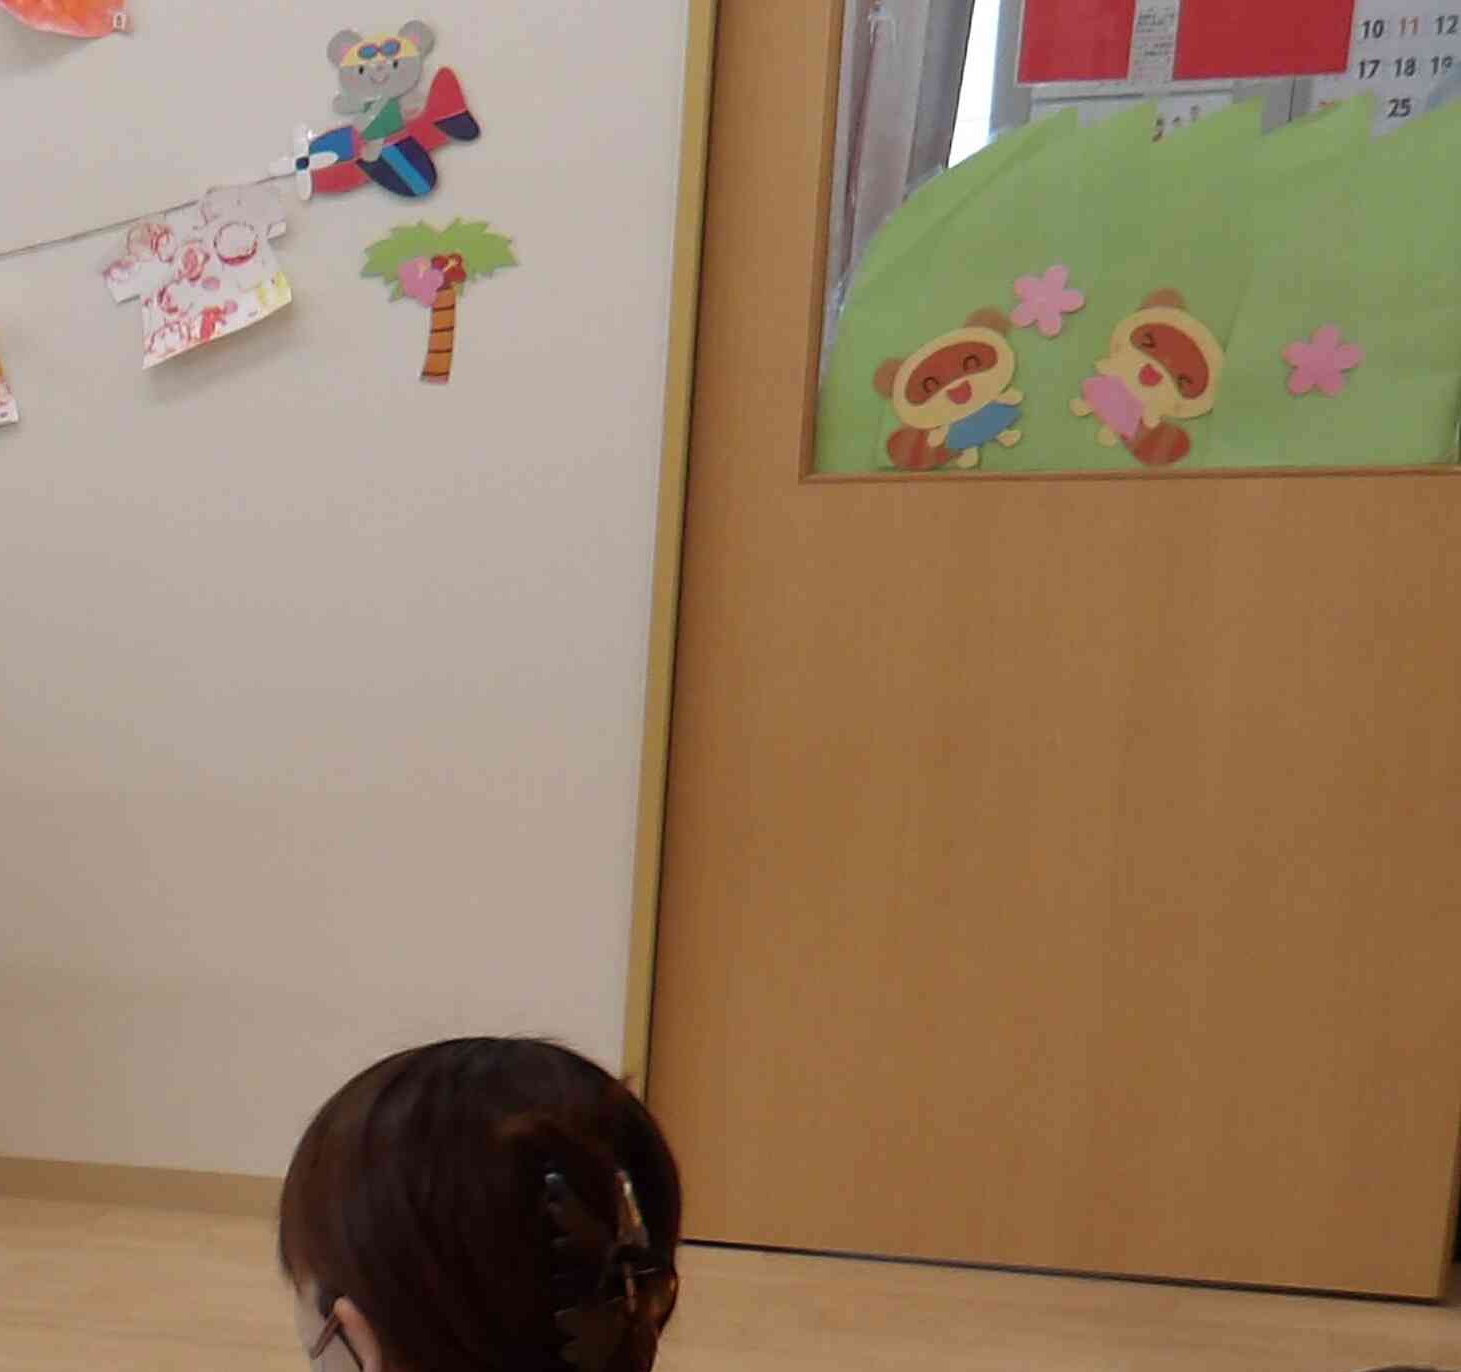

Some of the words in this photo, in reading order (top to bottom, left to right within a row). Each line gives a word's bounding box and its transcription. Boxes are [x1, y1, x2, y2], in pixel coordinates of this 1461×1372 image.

[1361, 19, 1384, 39] 10
[1399, 16, 1419, 36] 11
[1435, 14, 1459, 36] 12
[1359, 58, 1381, 79] 17
[1394, 56, 1417, 78] 18
[1387, 97, 1413, 119] 25
